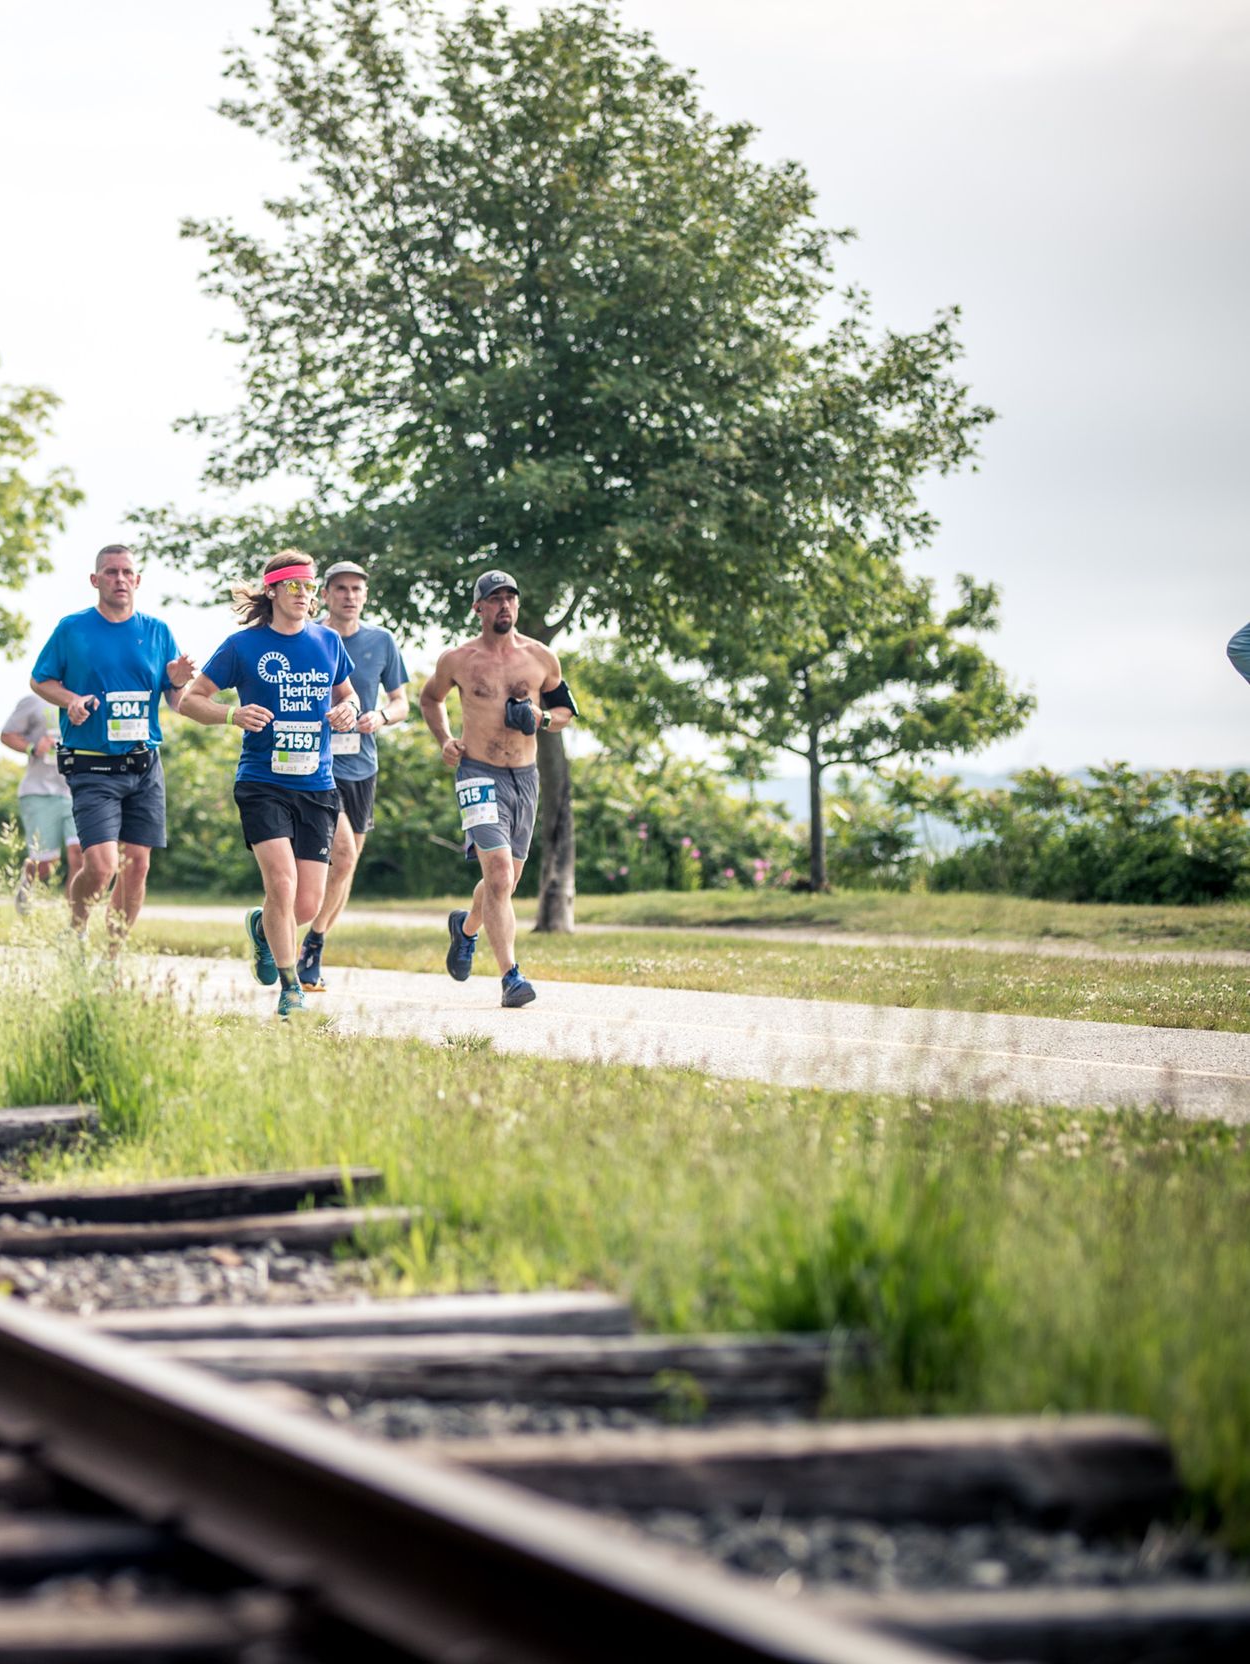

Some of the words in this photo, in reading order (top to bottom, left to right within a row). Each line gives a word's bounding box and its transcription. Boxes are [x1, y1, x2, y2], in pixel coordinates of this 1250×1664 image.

[277, 668, 329, 686] Peoples
[279, 684, 331, 701] Heritage
[112, 702, 140, 717] 904
[280, 697, 312, 712] Bank
[275, 732, 313, 749] 2159
[459, 787, 481, 806] 815
